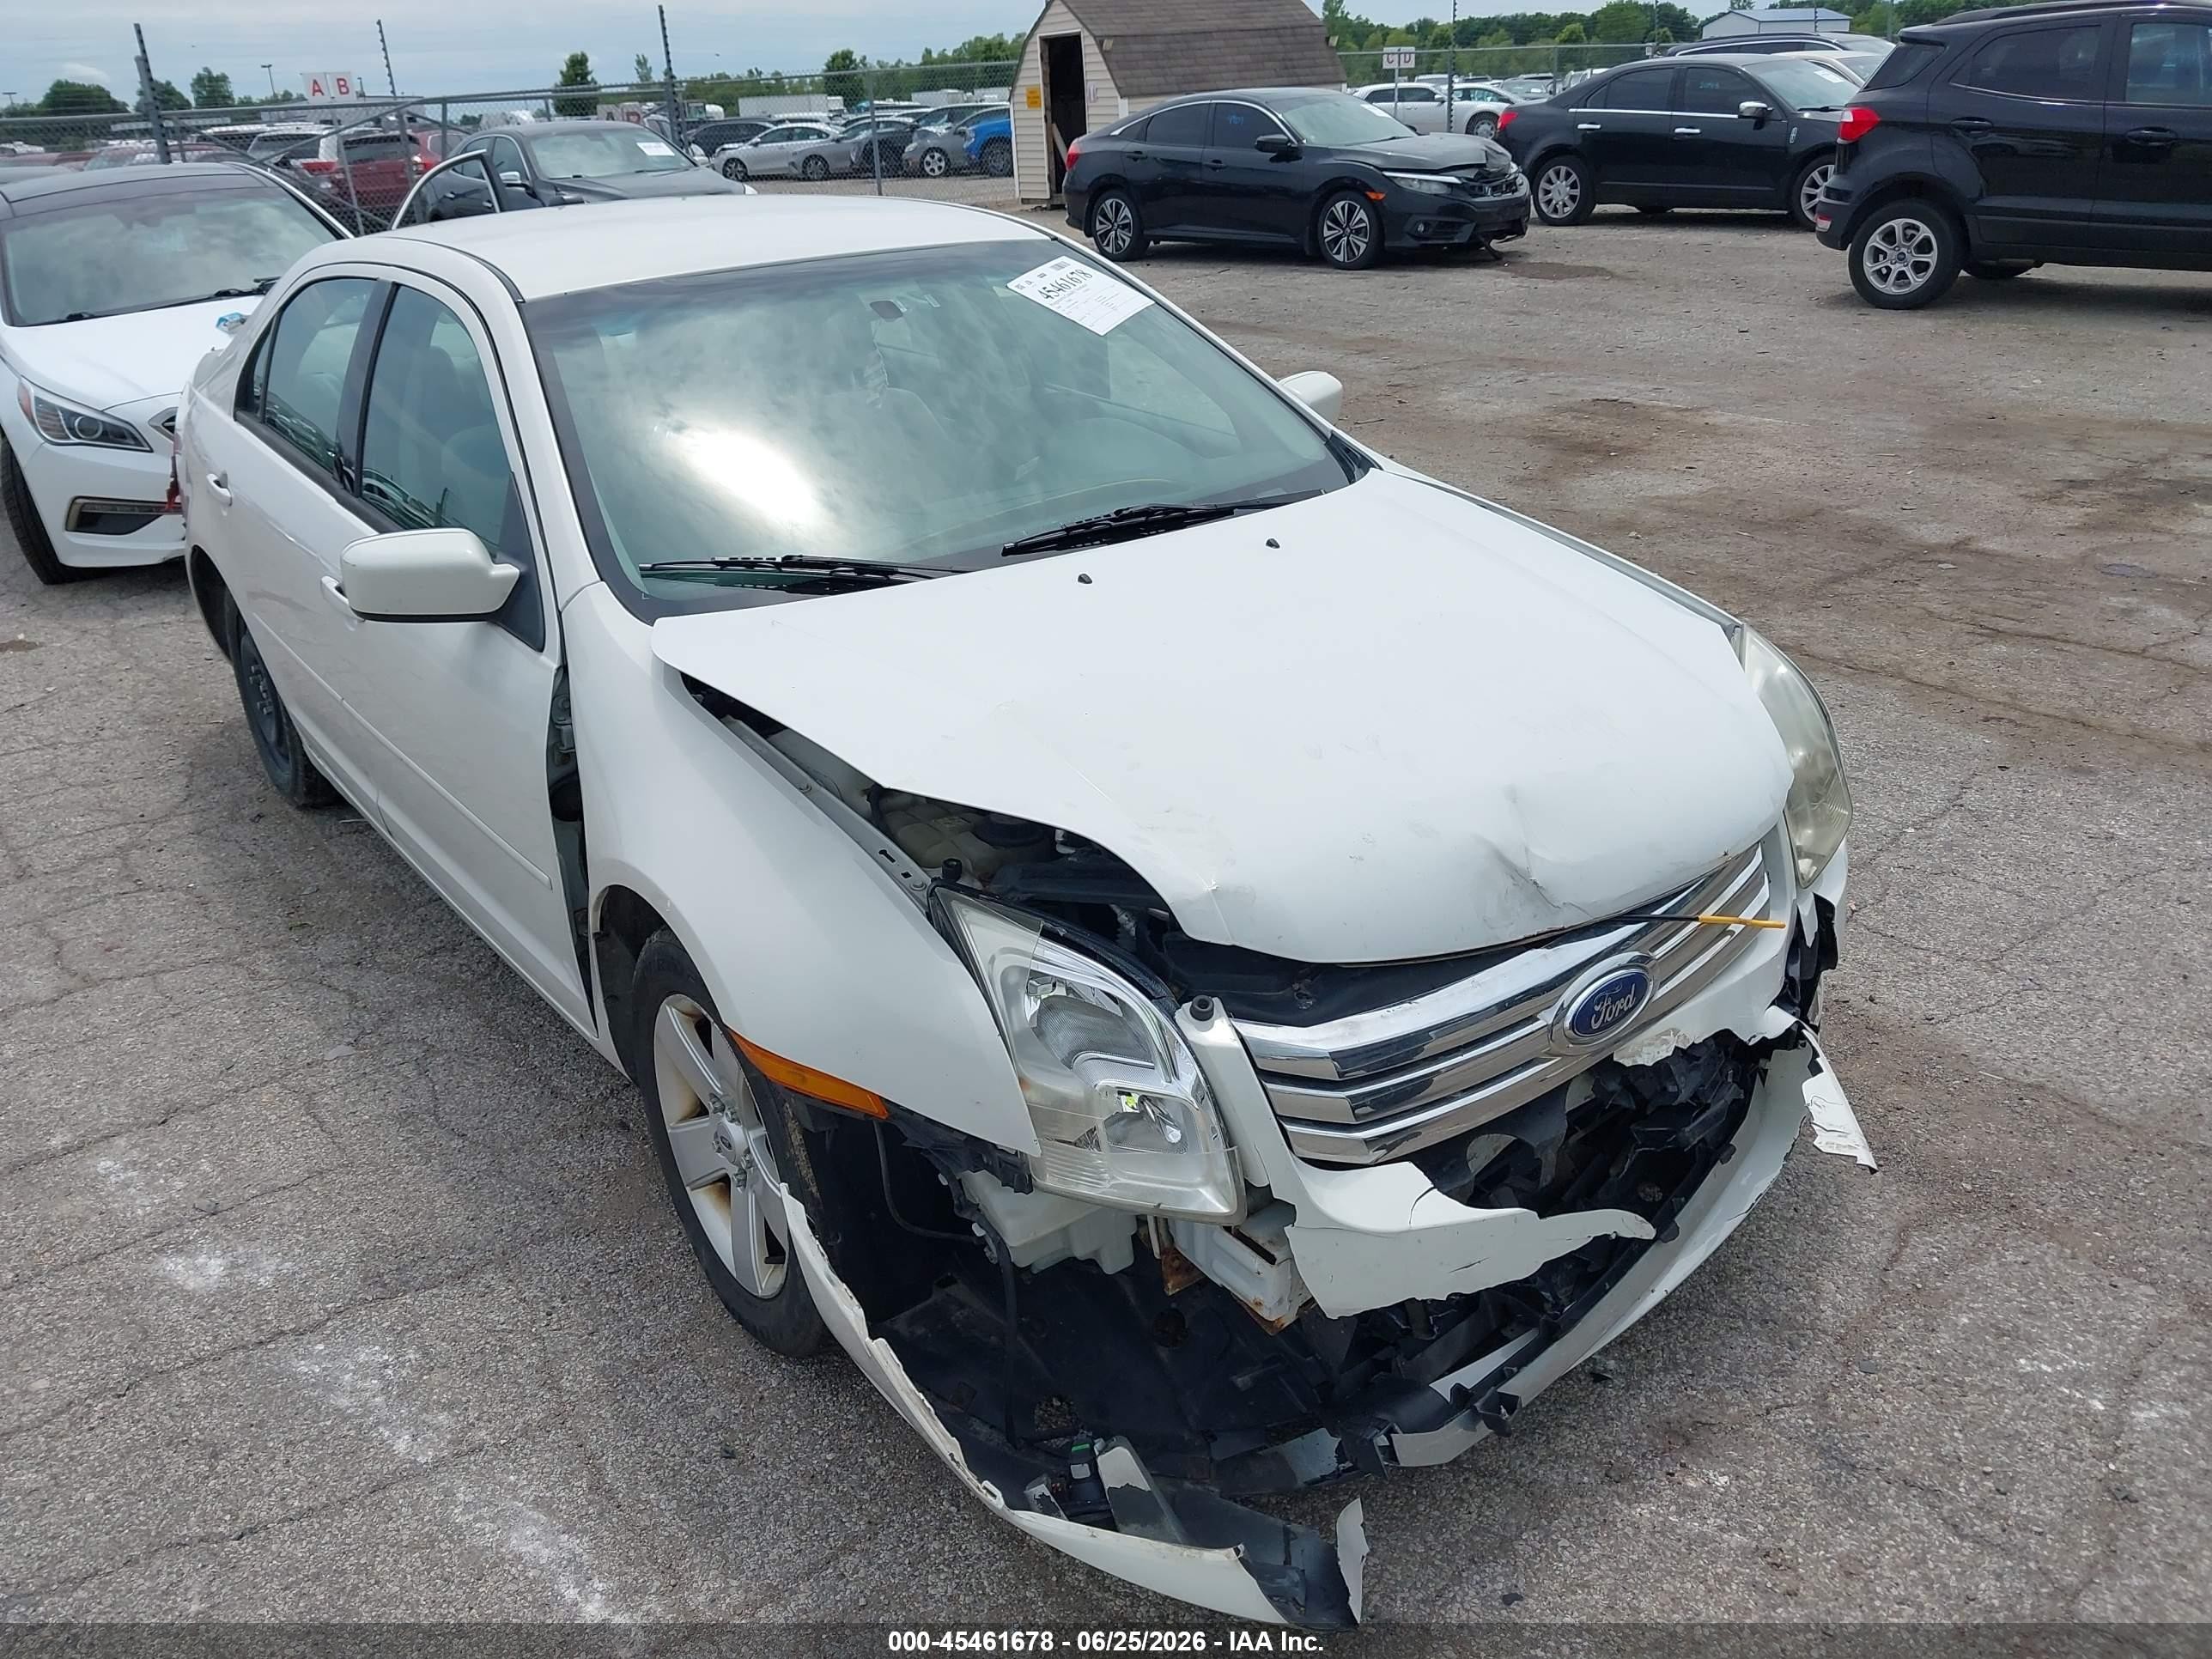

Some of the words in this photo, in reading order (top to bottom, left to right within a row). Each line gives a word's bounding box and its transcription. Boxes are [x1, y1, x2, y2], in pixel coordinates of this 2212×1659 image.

[312, 78, 325, 97] A
[336, 77, 349, 96] B
[1037, 269, 1093, 300] 45461678
[1590, 981, 1637, 1030] Ford
